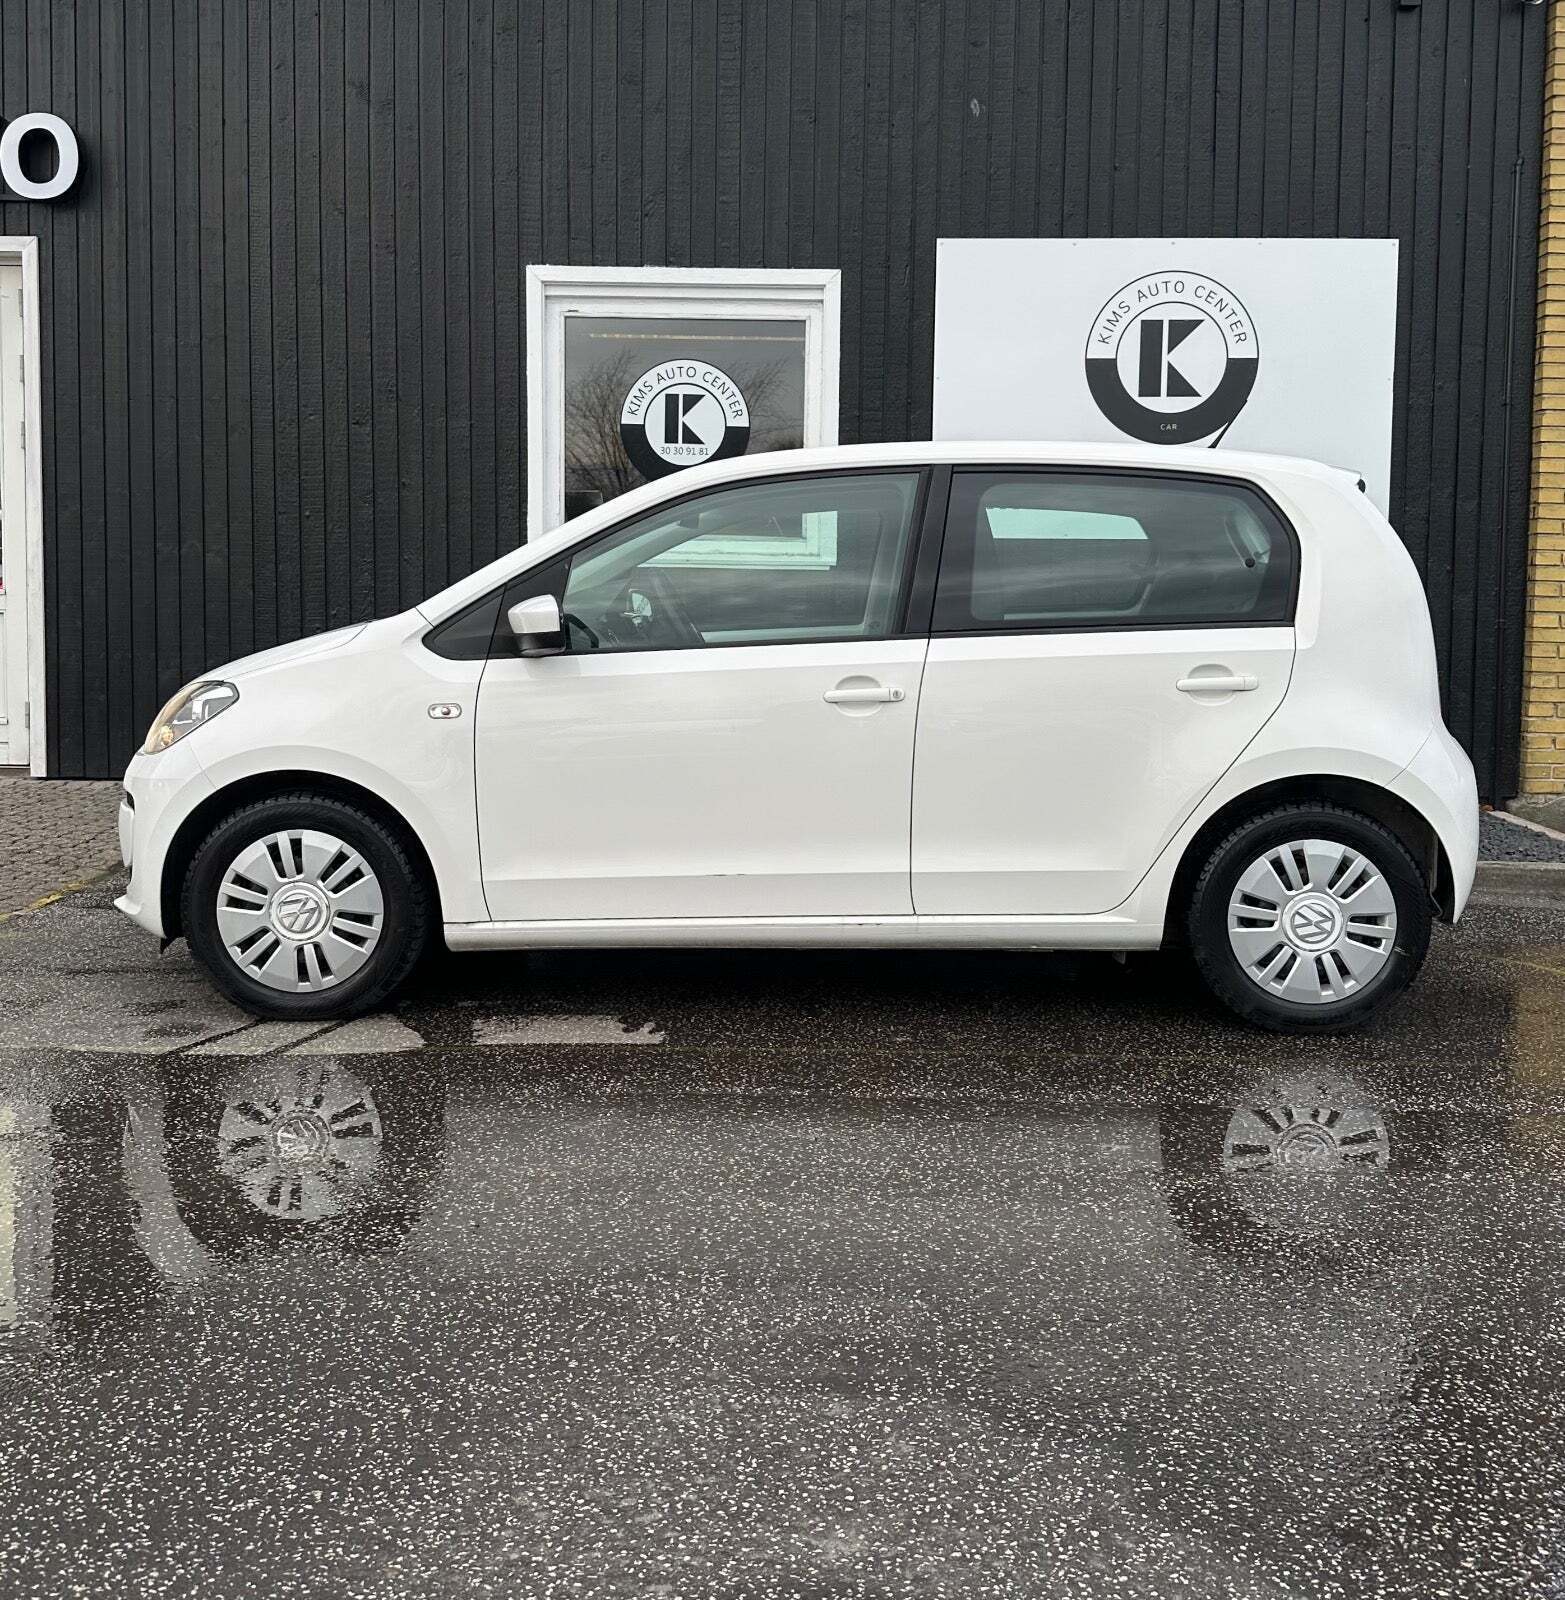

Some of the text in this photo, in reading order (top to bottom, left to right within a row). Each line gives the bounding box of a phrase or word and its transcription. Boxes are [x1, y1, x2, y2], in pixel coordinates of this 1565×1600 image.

[1098, 280, 1247, 345] KIMS AUTO CENTER
[1138, 319, 1206, 398] K
[627, 366, 743, 419] KIMS AUTO CENTER
[664, 393, 707, 445] K
[1160, 423, 1177, 431] CAR
[660, 446, 709, 456] 30 30 91 81
